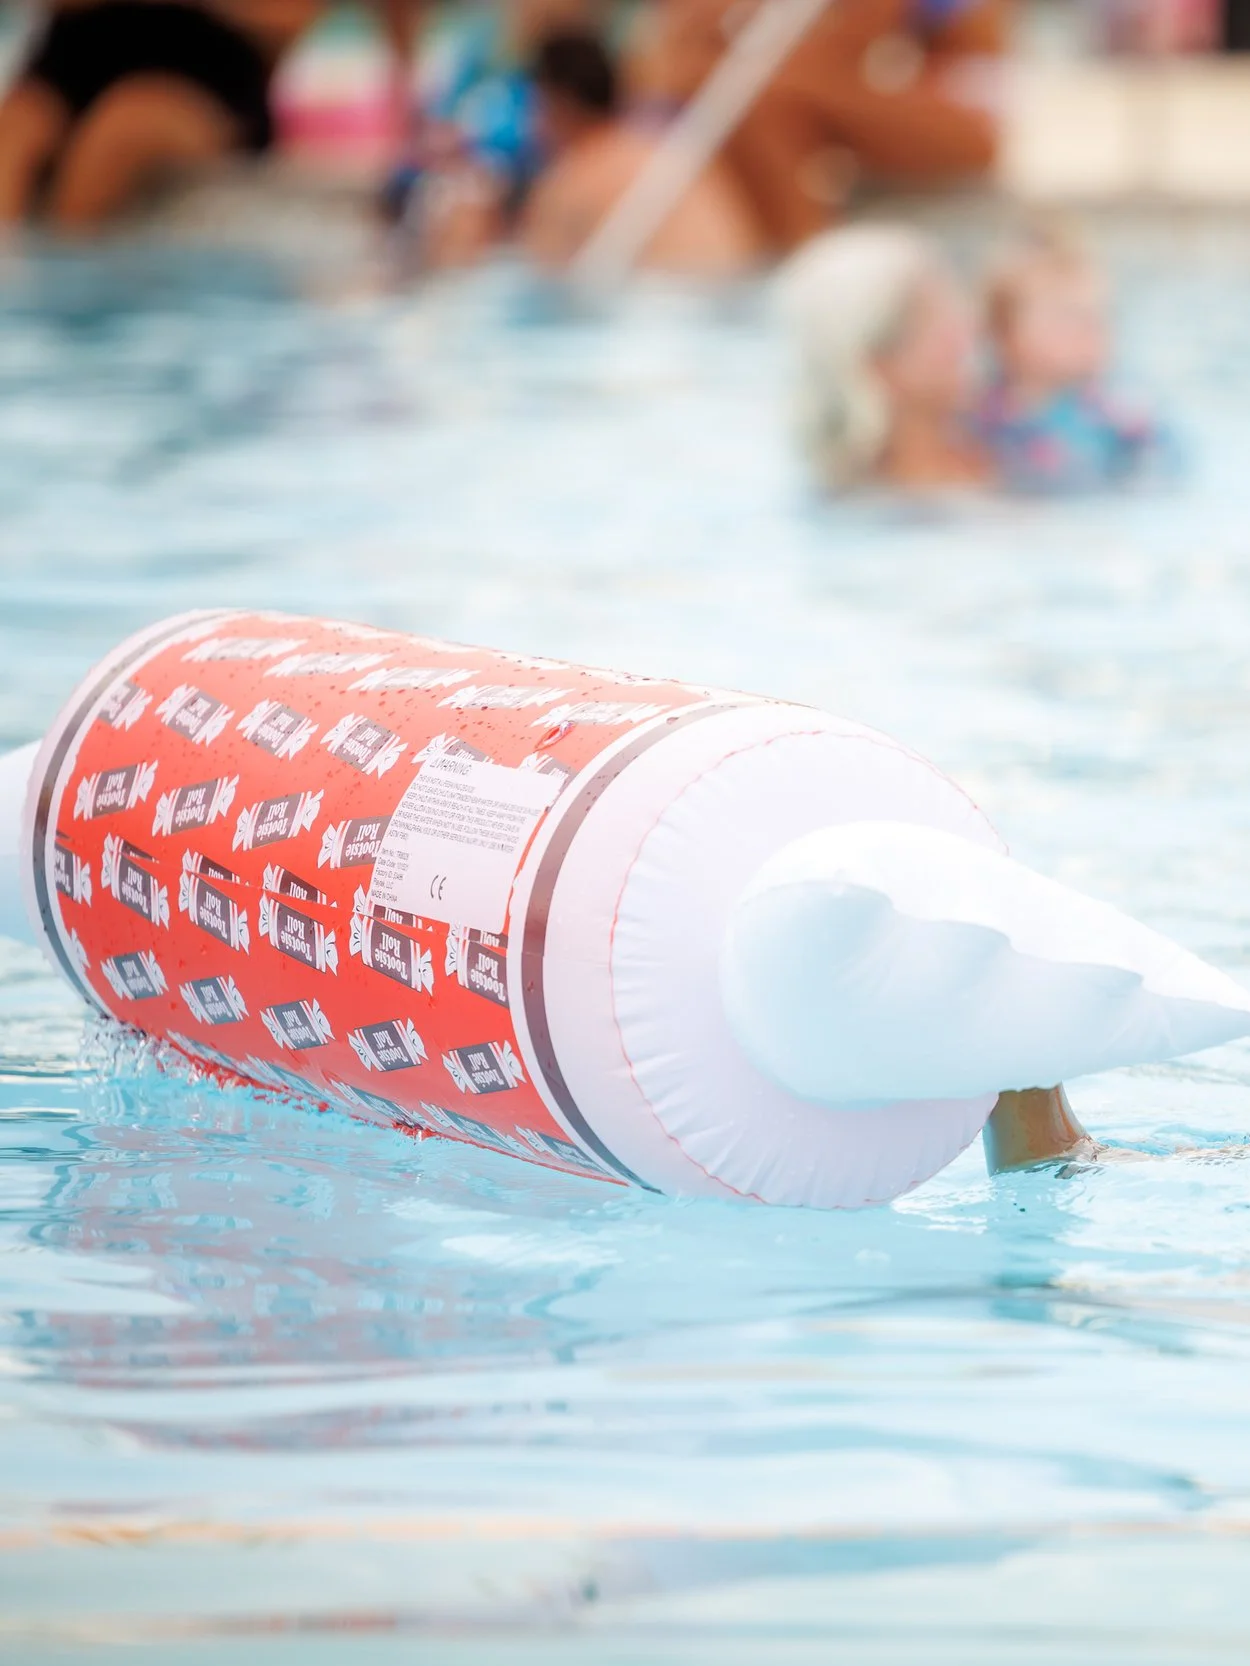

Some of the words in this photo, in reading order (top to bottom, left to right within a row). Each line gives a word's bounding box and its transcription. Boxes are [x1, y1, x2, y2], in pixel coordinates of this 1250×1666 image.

[106, 772, 126, 789] Roll
[96, 789, 126, 811] Tootsie
[186, 788, 206, 806] Roll
[175, 805, 205, 827] Tootsie
[267, 802, 289, 821] Roll
[257, 819, 289, 841] Tootsie
[357, 823, 381, 841] Roll
[128, 867, 143, 887] Roll
[121, 881, 149, 914] Tootsie
[205, 891, 221, 915] Roll
[200, 906, 228, 939] Tootsie
[287, 915, 305, 935] Roll
[281, 931, 313, 962] Tootsie
[381, 932, 400, 957] Roll
[375, 948, 408, 981] Tootsie
[478, 953, 498, 979] Roll
[470, 969, 505, 1002] Tootsie
[282, 1009, 302, 1026] Roll
[287, 1026, 316, 1043] Tootsie
[373, 1030, 394, 1047] Roll
[376, 1046, 408, 1065] Tootsie
[467, 1052, 490, 1069] Roll
[472, 1069, 504, 1087] Tootsie
